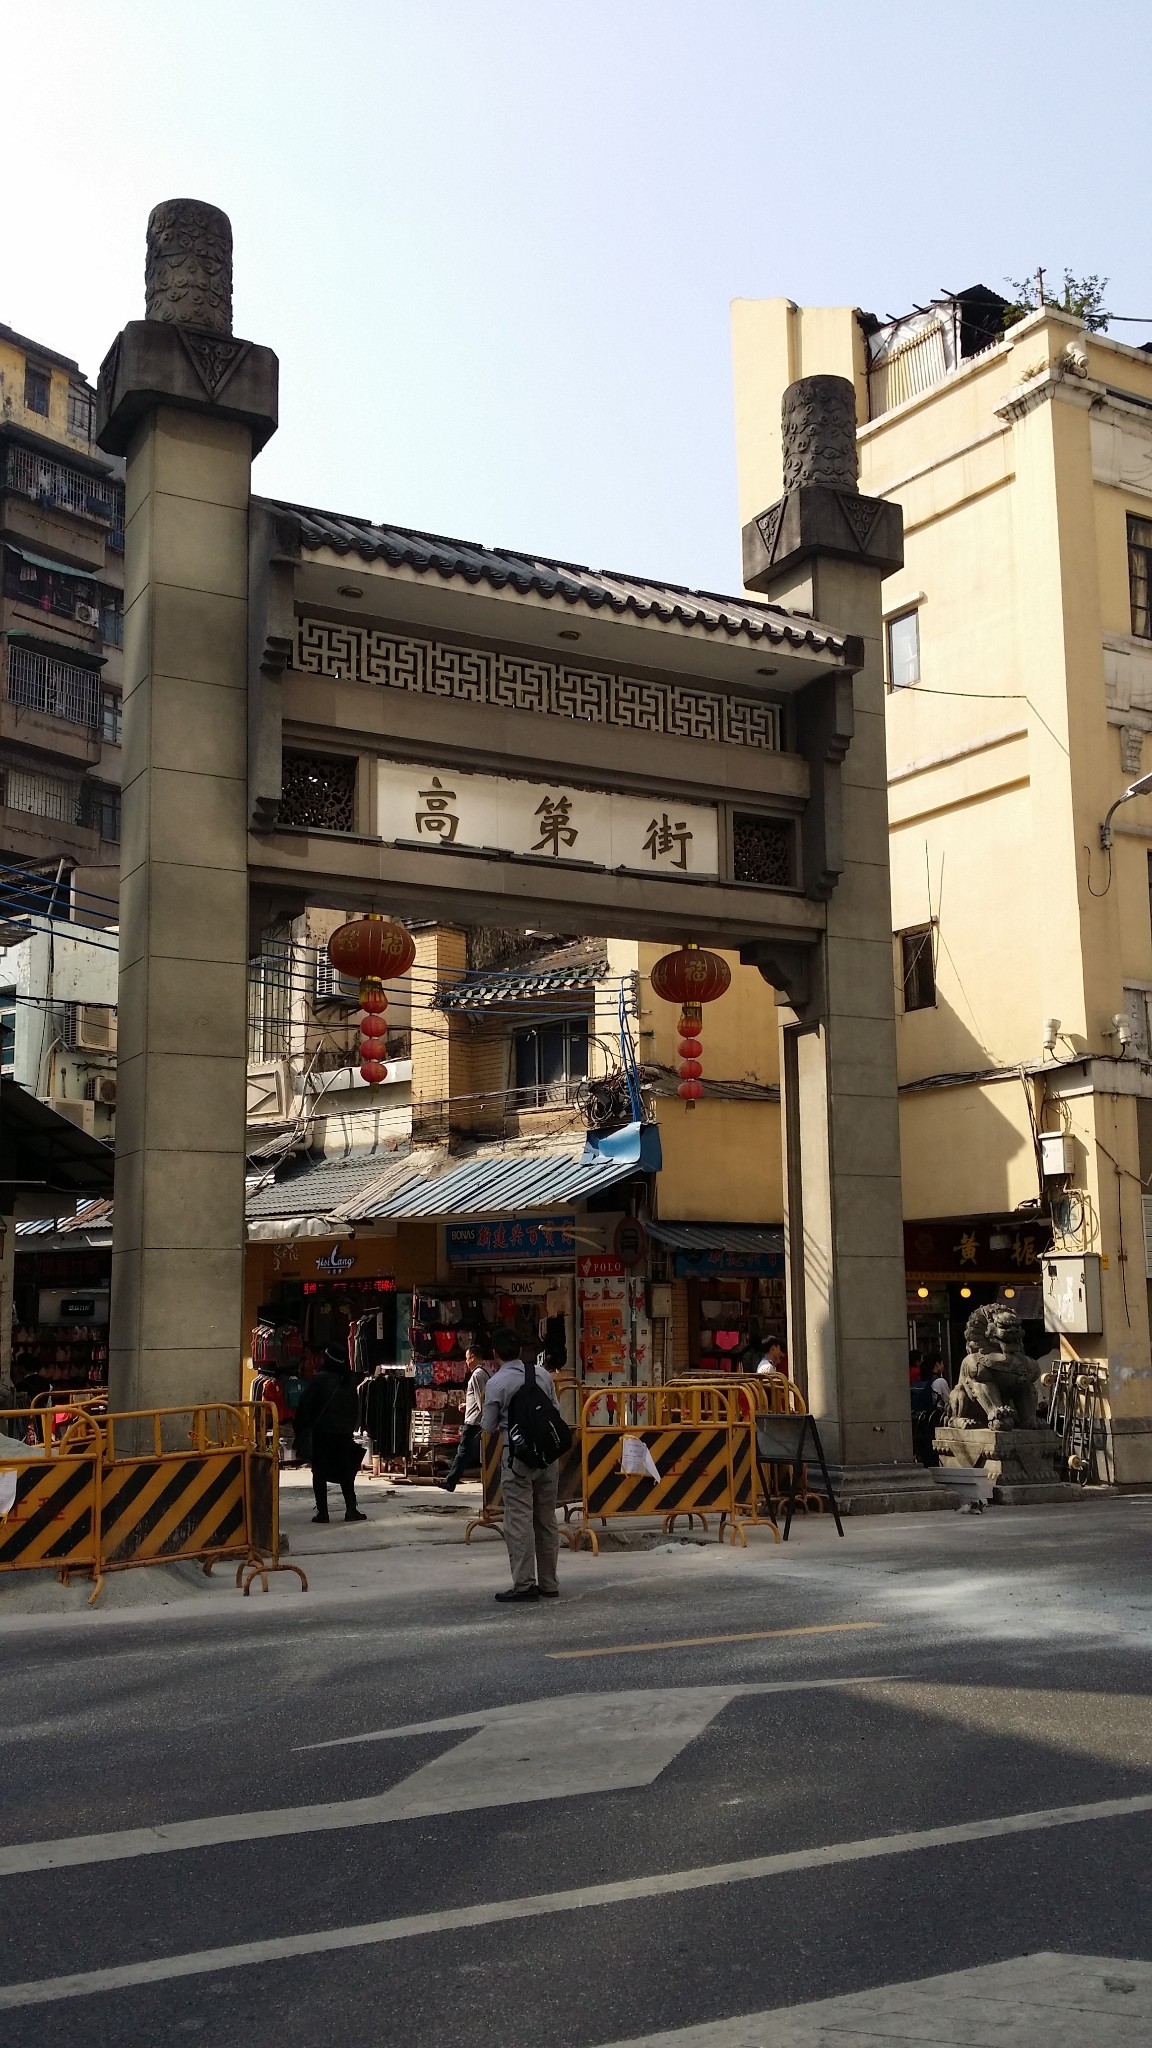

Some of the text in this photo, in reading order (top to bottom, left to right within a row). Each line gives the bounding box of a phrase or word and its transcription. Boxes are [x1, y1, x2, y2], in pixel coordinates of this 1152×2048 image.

[415, 776, 693, 870] 高第街
[382, 929, 404, 955] 福
[684, 960, 708, 982] 福
[451, 1229, 476, 1241] BONAS
[594, 1262, 621, 1272] POLO
[511, 1282, 533, 1292] BONAS
